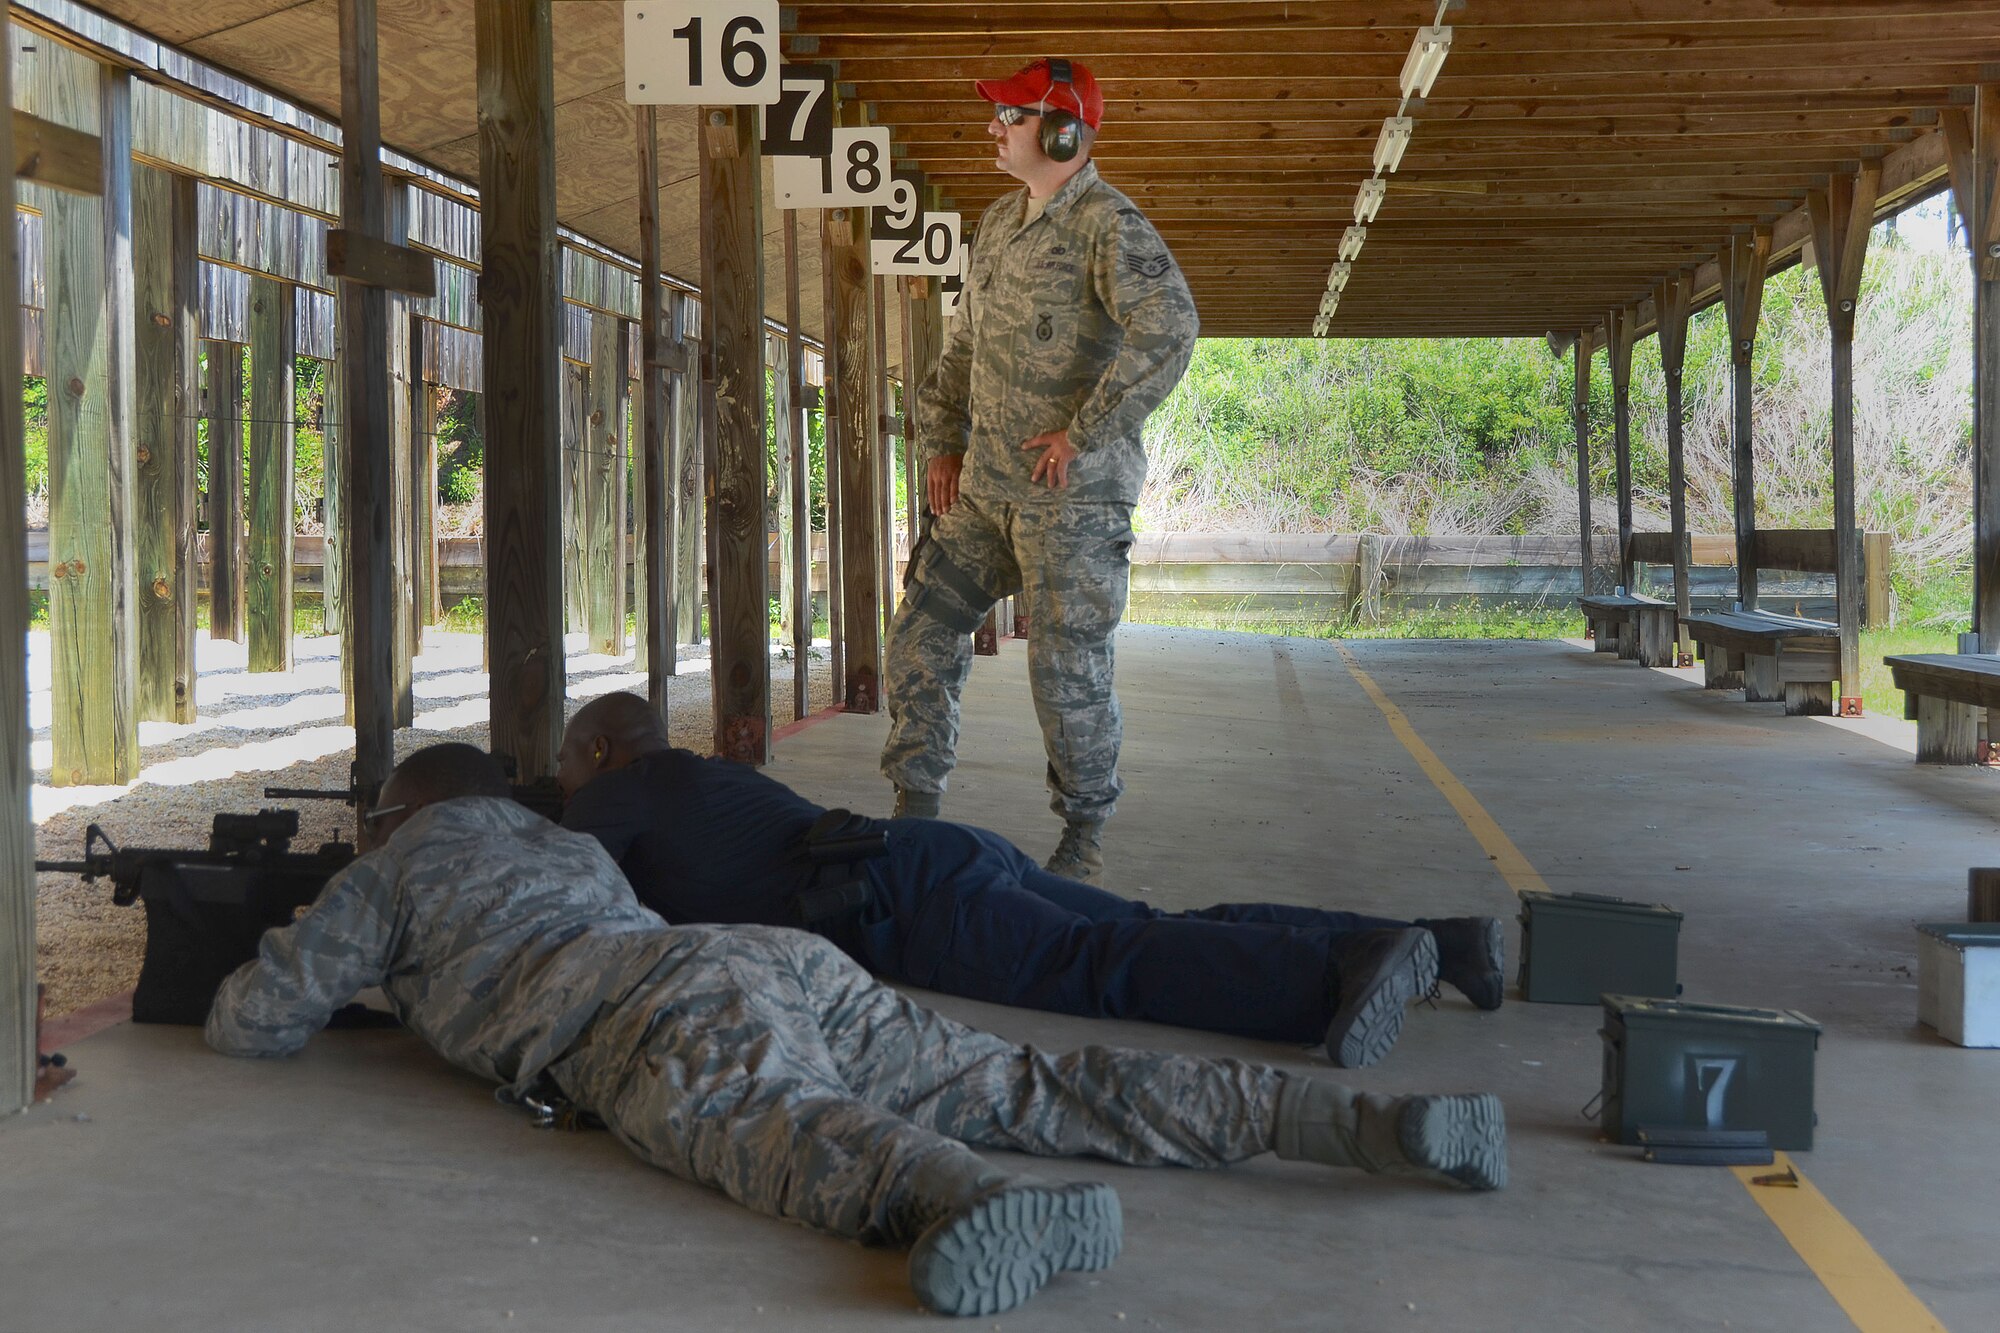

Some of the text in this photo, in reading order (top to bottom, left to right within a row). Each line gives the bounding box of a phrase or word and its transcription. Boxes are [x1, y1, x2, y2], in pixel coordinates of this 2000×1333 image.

[673, 16, 767, 87] 16
[892, 222, 953, 265] 20
[1695, 1059, 1737, 1130] 7
